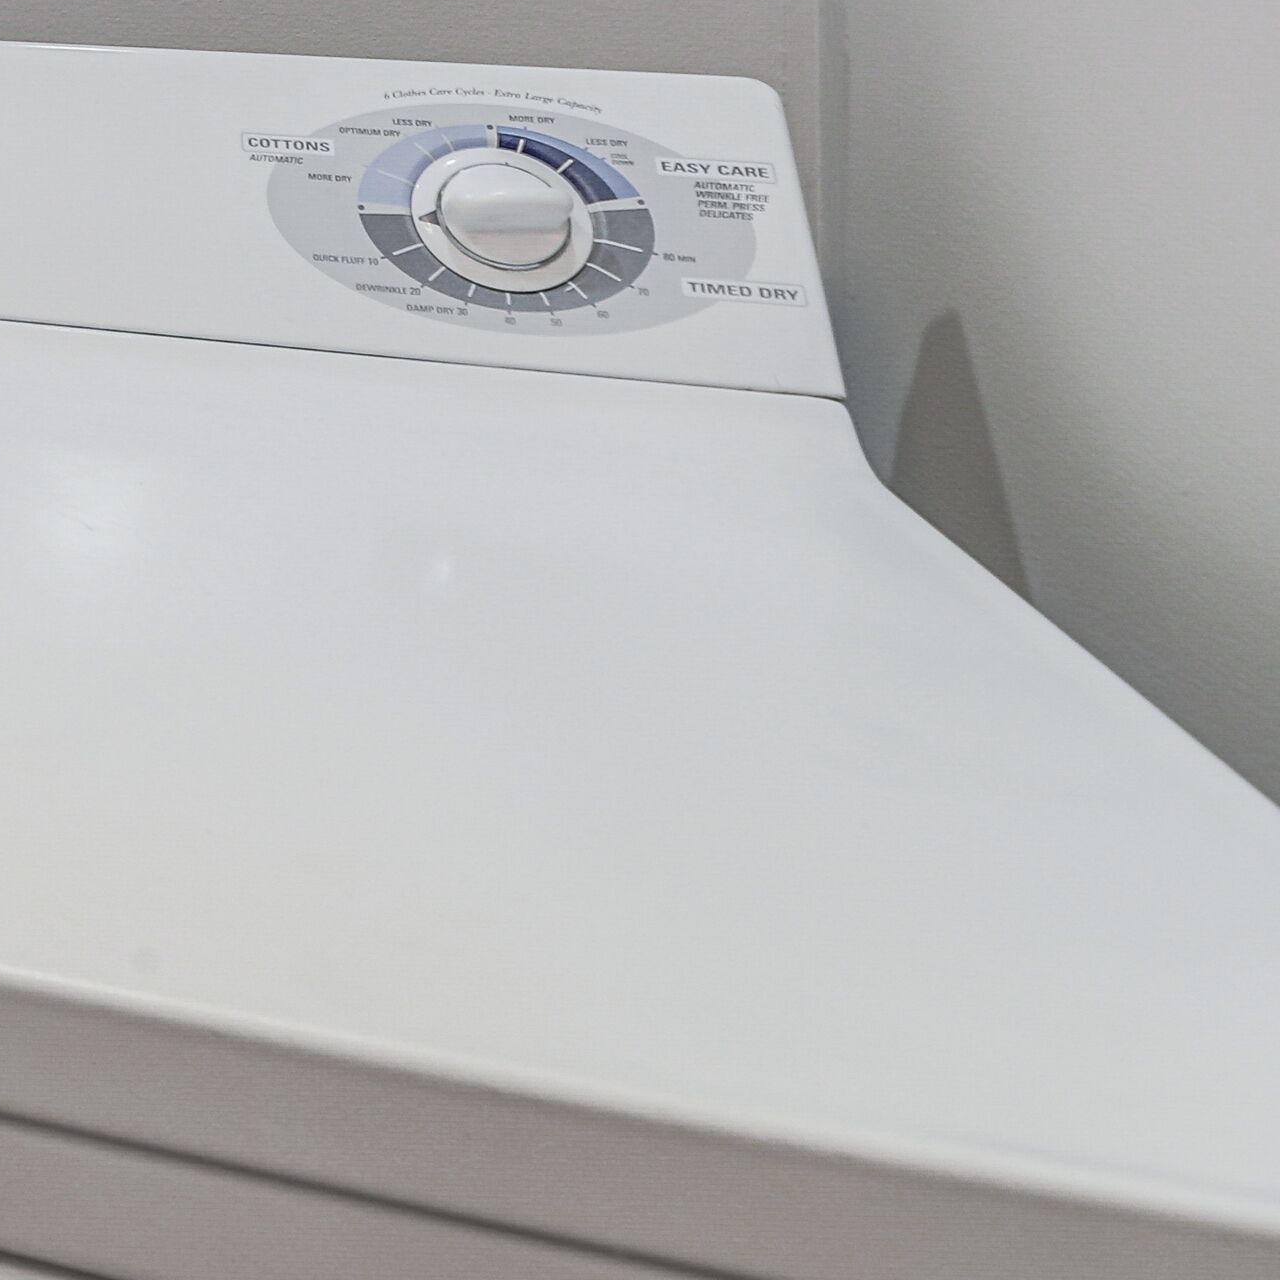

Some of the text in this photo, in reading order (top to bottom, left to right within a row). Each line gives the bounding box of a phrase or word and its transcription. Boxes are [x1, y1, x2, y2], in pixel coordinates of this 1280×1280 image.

[392, 89, 426, 99] Clothes
[429, 87, 453, 96] Care
[455, 87, 485, 97] Cycles
[494, 89, 521, 99] Extra
[525, 92, 553, 104] Large
[557, 97, 602, 114] Capacity
[391, 118, 433, 127] LESS DRY
[508, 114, 555, 124] MORE DRY
[339, 126, 401, 137] OPTIMUM DRY
[247, 137, 331, 152] COTTONS
[585, 137, 629, 147] LESS DRY
[249, 153, 304, 165] AUTOMATIC
[661, 161, 770, 179] EASY CARE
[307, 172, 352, 183] MORE DRY
[694, 181, 755, 192] AUTOMATIC
[695, 190, 770, 203] WRINKLE FREE
[732, 201, 766, 212] PRESS
[699, 209, 754, 221] DELICATES
[312, 253, 379, 266] QUICK FLUFF 10
[677, 255, 696, 263] MIN
[355, 283, 421, 296] DEWRINKLE 20
[687, 281, 799, 301] TIMED DRY
[406, 304, 469, 316] DAMP DRY 30
